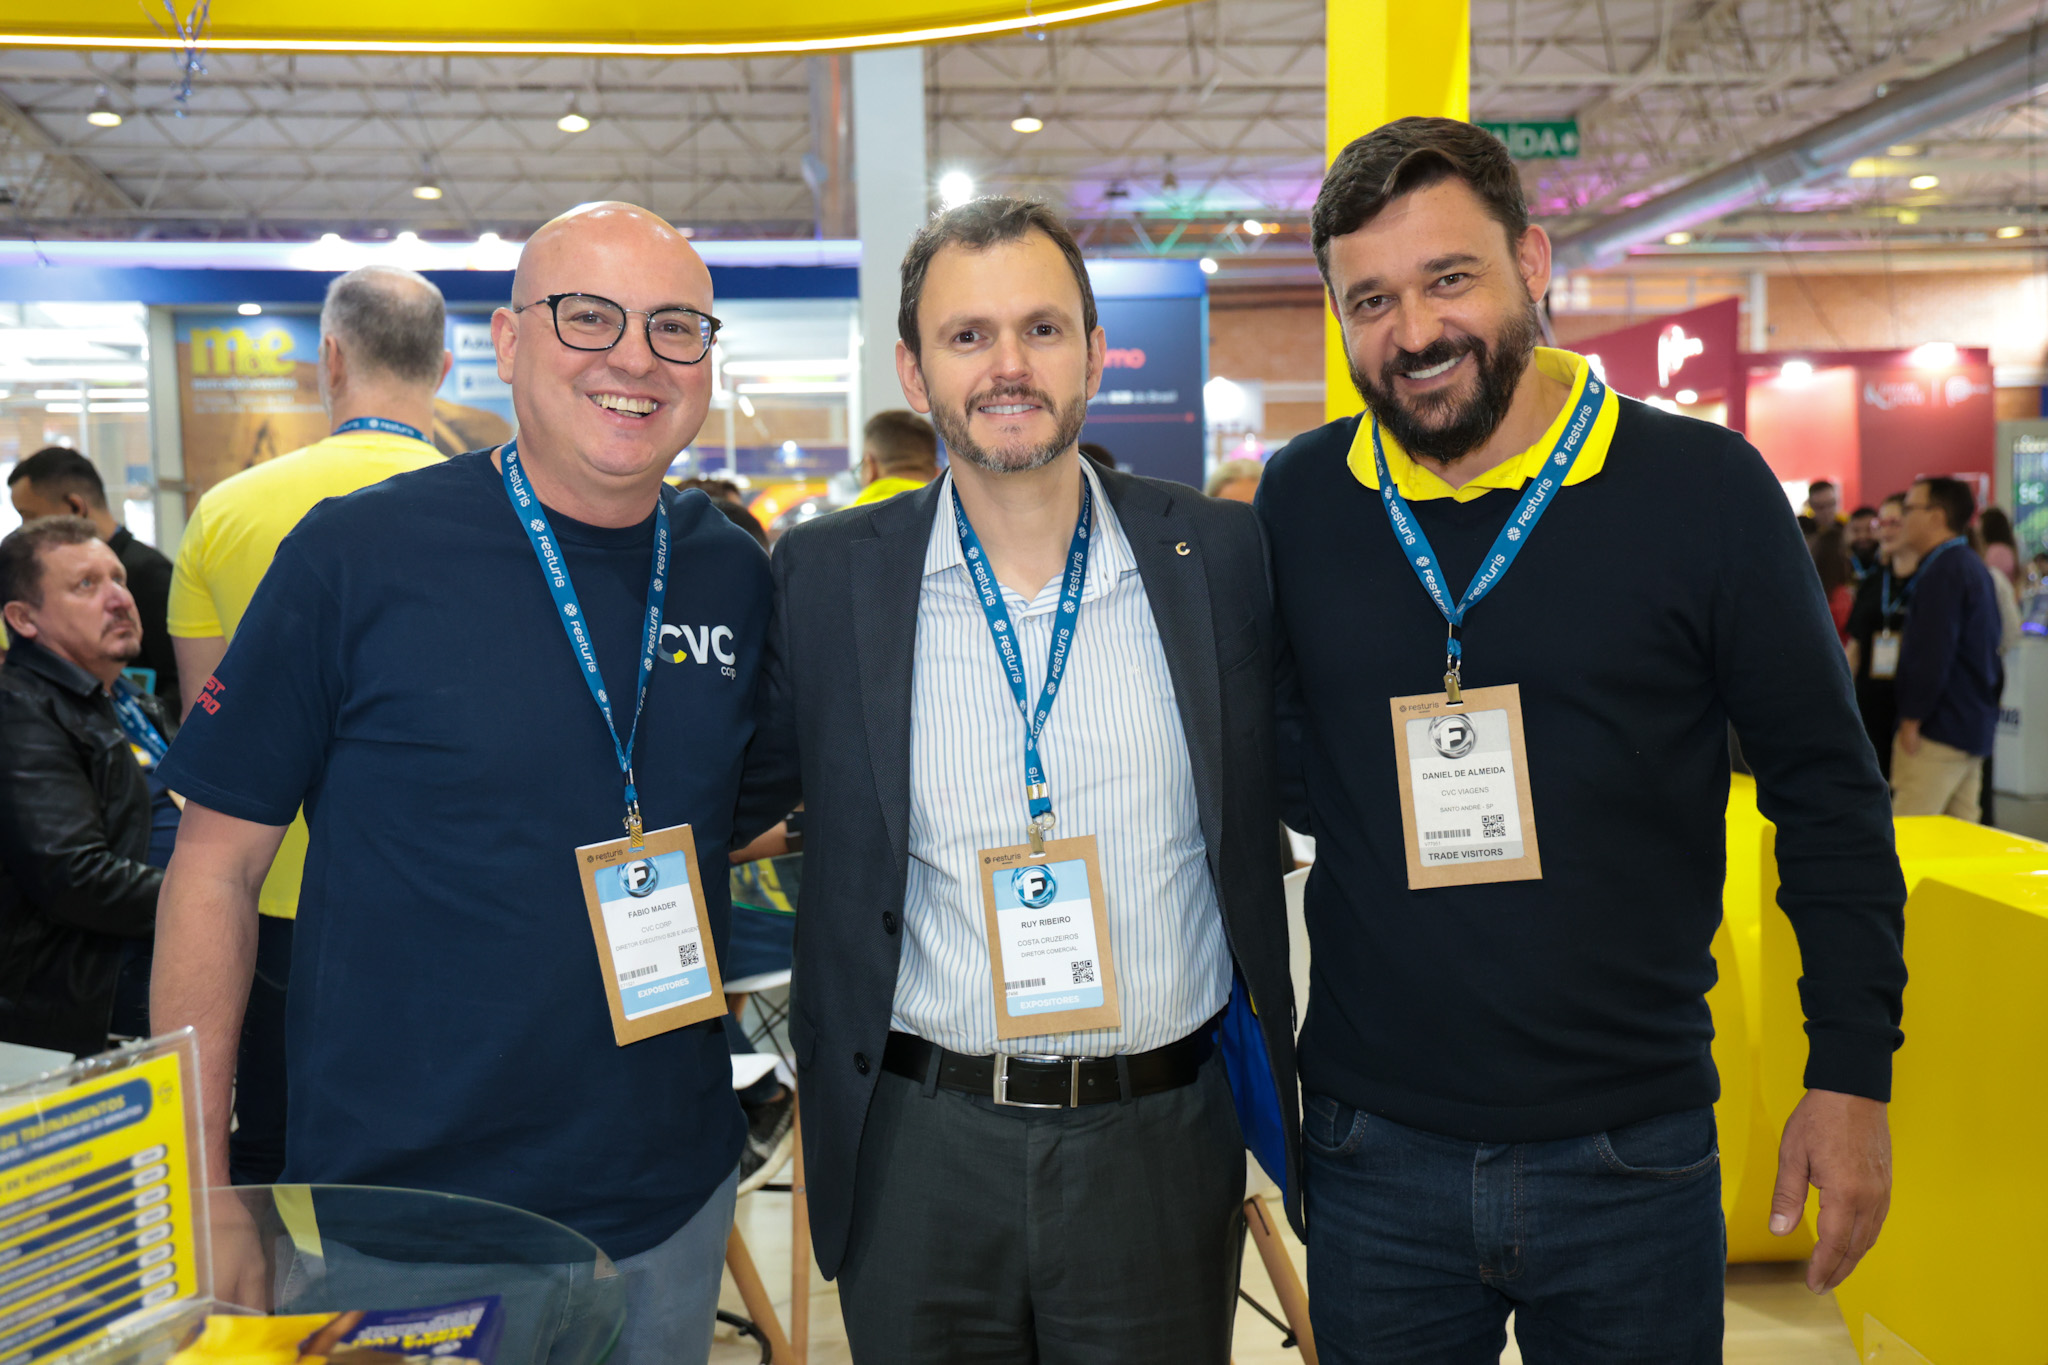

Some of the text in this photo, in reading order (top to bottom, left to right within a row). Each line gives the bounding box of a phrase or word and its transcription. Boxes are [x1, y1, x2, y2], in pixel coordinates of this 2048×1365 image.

[1564, 404, 1592, 451] Festuris
[508, 463, 531, 508] Festuris
[1518, 478, 1553, 527] Festuris
[1388, 500, 1416, 546] Festuris
[538, 535, 565, 588] Festuris
[656, 528, 667, 577] Festuris
[973, 560, 996, 607] Festuris
[1068, 551, 1084, 598] Festuris
[1468, 553, 1506, 601] Festuris
[647, 606, 659, 655] Festuris
[570, 620, 597, 673] Festuris
[657, 624, 736, 666] CVC
[1052, 628, 1070, 679] Festuris
[999, 635, 1022, 684] Festuris
[1408, 701, 1440, 712] Festuris
[1422, 766, 1506, 780] DANIEL DE ALMEIDA
[1441, 786, 1490, 797] CVC VIAGENS
[1440, 806, 1460, 814] SANTO
[595, 848, 623, 862] Festuris
[992, 853, 1022, 863] Festuris
[1428, 848, 1504, 861] TRADE VISITORS
[628, 901, 677, 919] FABIO MADER
[641, 920, 672, 933] CVC CORP
[1021, 916, 1071, 929] RUY RIBEIRO
[615, 941, 639, 952] DIRETOR
[639, 934, 667, 946] EXECUTIVO
[1017, 933, 1079, 947] COSTA CRUZEIROS
[1021, 945, 1078, 958] DIRETOR COMERCIAL
[637, 977, 690, 998] EXPOSITORES
[1020, 995, 1080, 1009] EXPOSITORES
